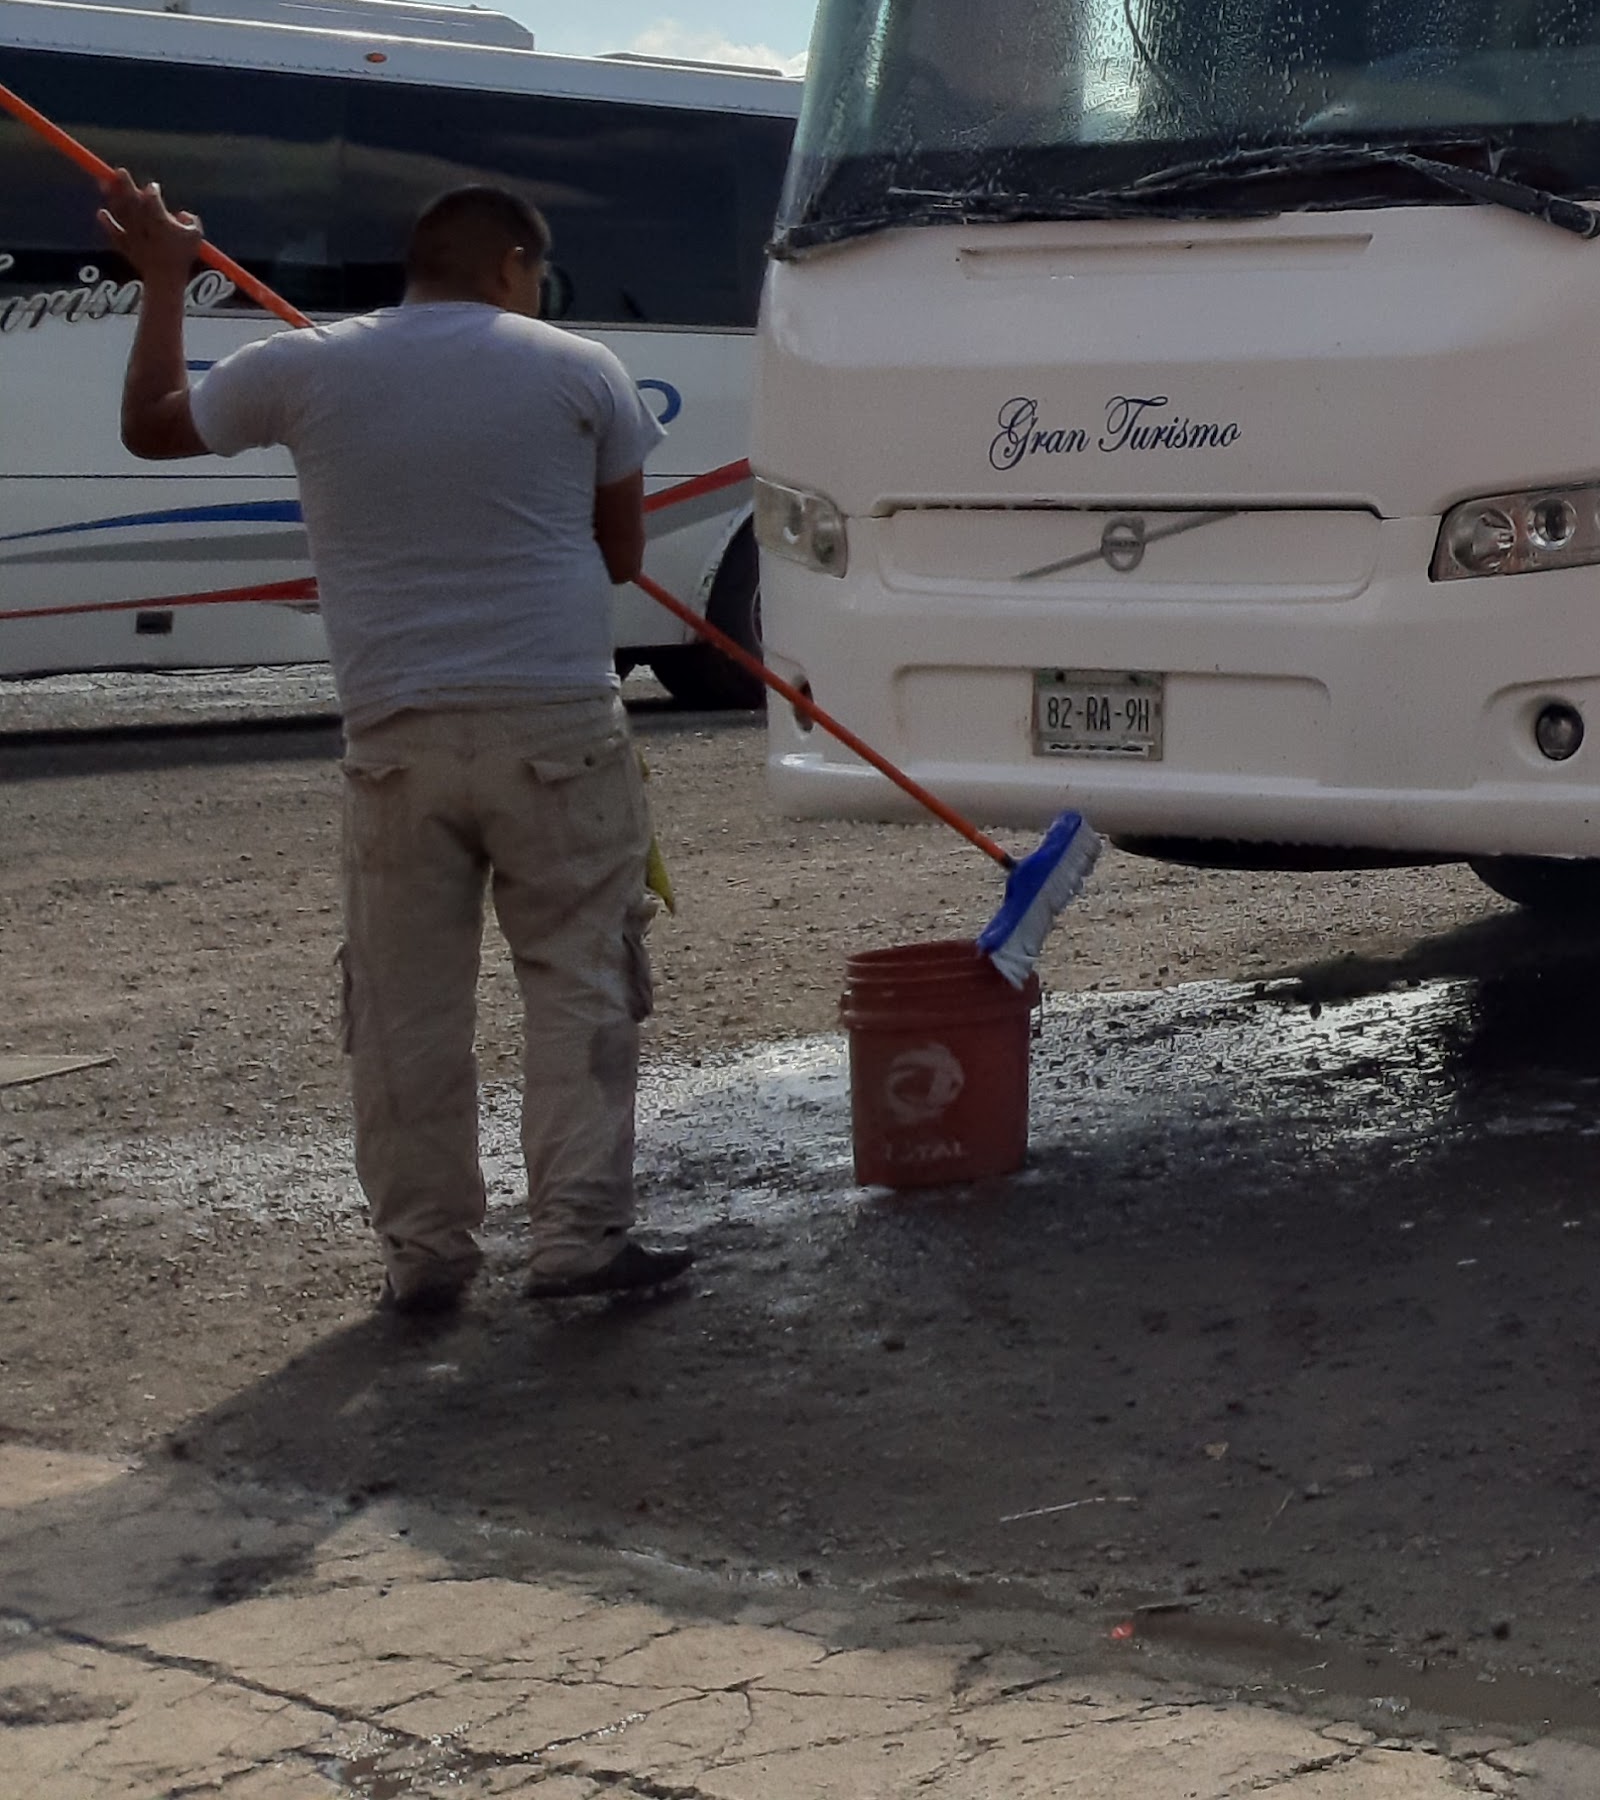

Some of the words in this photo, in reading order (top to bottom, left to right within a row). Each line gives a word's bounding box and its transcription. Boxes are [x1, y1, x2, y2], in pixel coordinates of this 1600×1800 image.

[988, 396, 1091, 471] Gran
[1098, 395, 1243, 453] Turismo
[1047, 695, 1150, 733] 82-RA-9H
